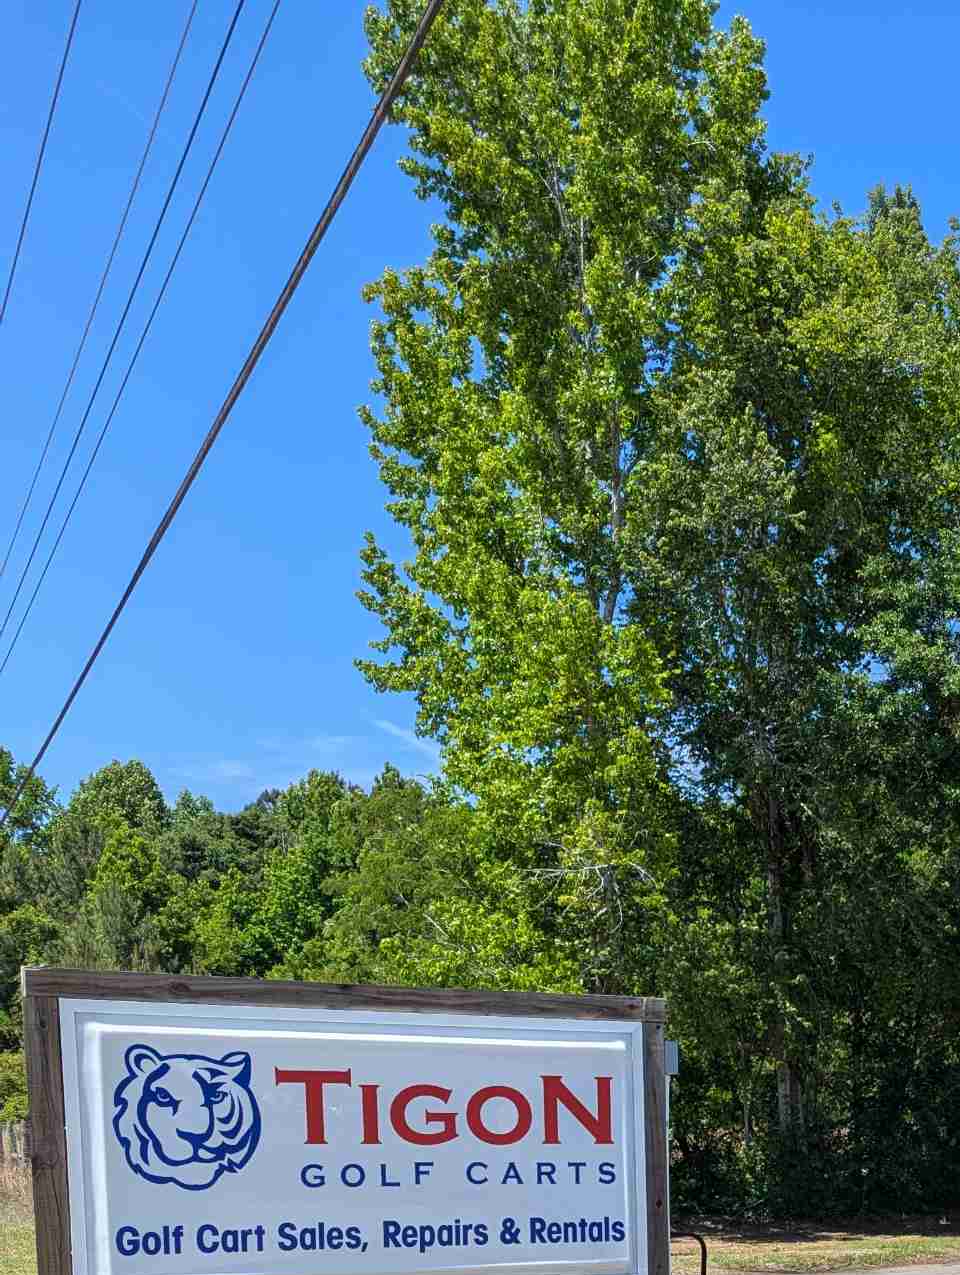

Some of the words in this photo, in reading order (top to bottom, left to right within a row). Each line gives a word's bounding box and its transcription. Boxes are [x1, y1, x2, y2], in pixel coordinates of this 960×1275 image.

[275, 1067, 613, 1145] TIGON
[300, 1161, 435, 1189] GOLF
[465, 1161, 618, 1185] CARTS
[115, 1224, 185, 1257] Golf
[196, 1223, 266, 1254] Cart
[277, 1220, 369, 1253] Sales,
[382, 1218, 489, 1254] Repairs
[499, 1217, 522, 1245] &
[529, 1215, 627, 1244] Rentals
